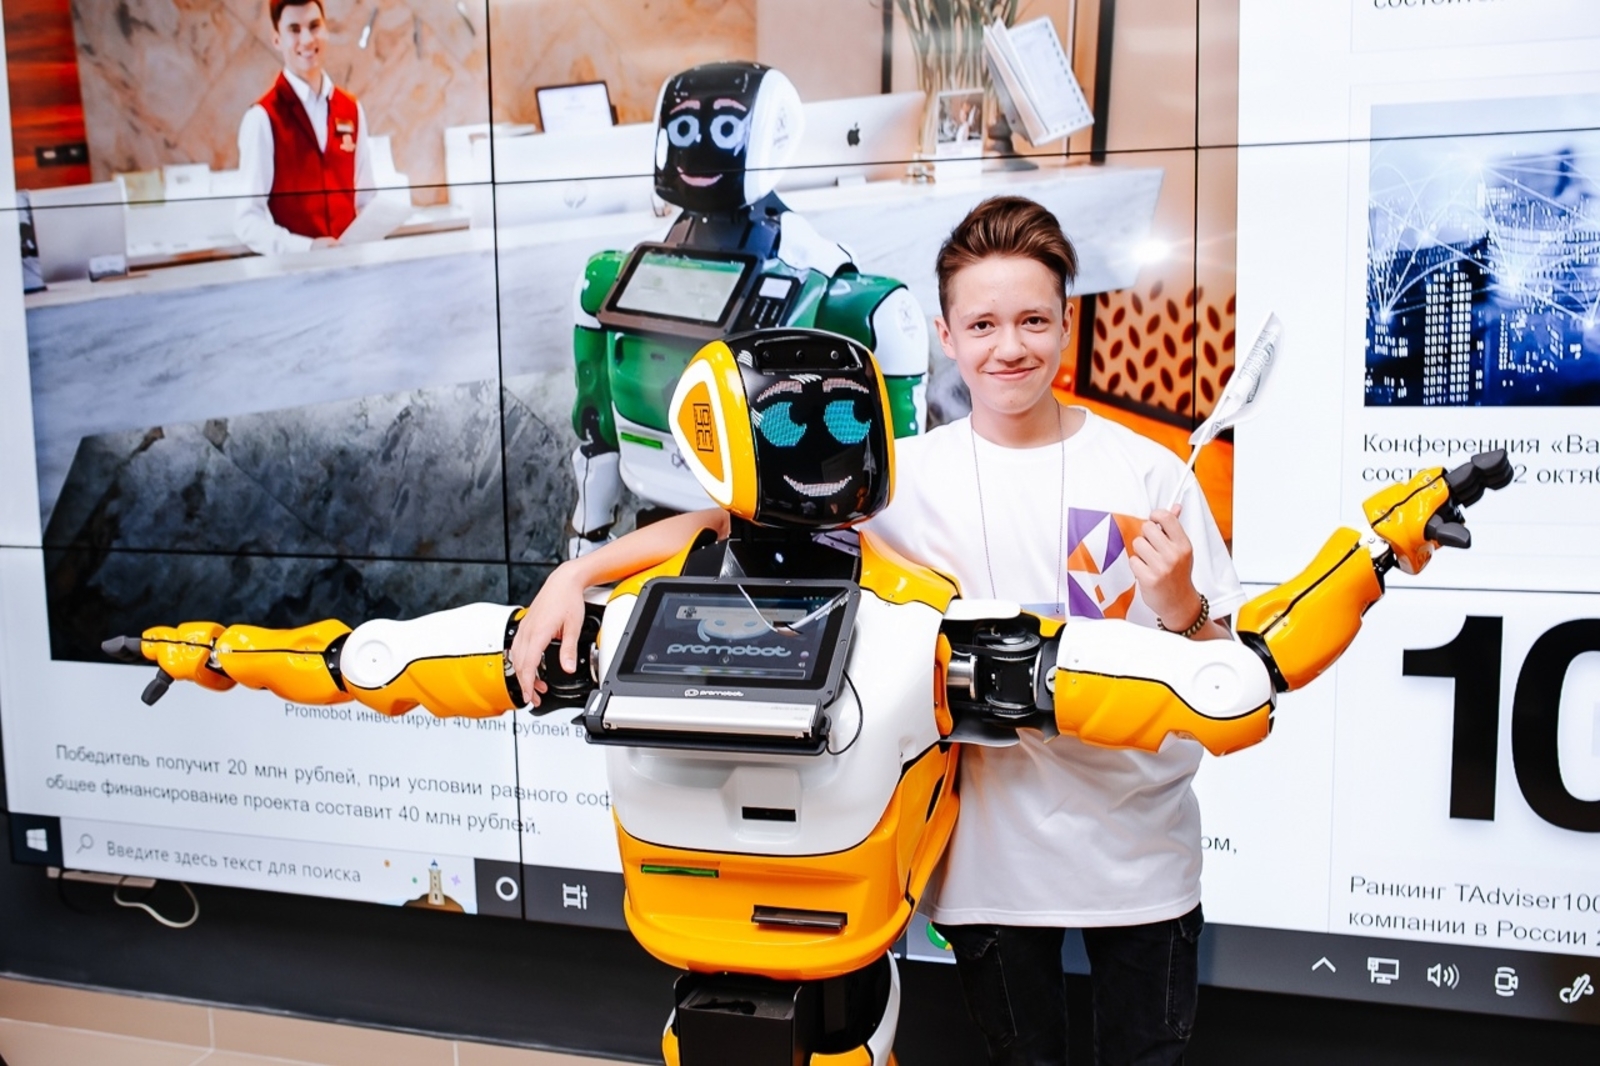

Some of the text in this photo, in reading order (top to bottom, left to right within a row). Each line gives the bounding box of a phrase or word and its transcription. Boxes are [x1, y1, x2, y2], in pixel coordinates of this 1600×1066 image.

[1363, 433, 1540, 458] Конференция
[667, 643, 792, 657] promobot
[284, 703, 352, 721] Promobot
[476, 716, 507, 731] млн
[513, 720, 570, 737] рублей
[55, 743, 150, 767] Победитель
[156, 756, 220, 775] получит
[227, 758, 248, 776] 20
[254, 764, 288, 779] млн
[294, 765, 361, 788] рублей,
[368, 773, 401, 791] при
[407, 777, 483, 795] условии
[491, 783, 568, 805] равного
[45, 774, 541, 836] общее финансирование проекта составит 40 млн рублей.
[107, 840, 362, 883] Введите здесь текст для поиска
[1350, 875, 1447, 900] Ранкинг
[1348, 912, 1466, 935] компании
[1474, 922, 1488, 937] в
[1496, 920, 1587, 947] России
